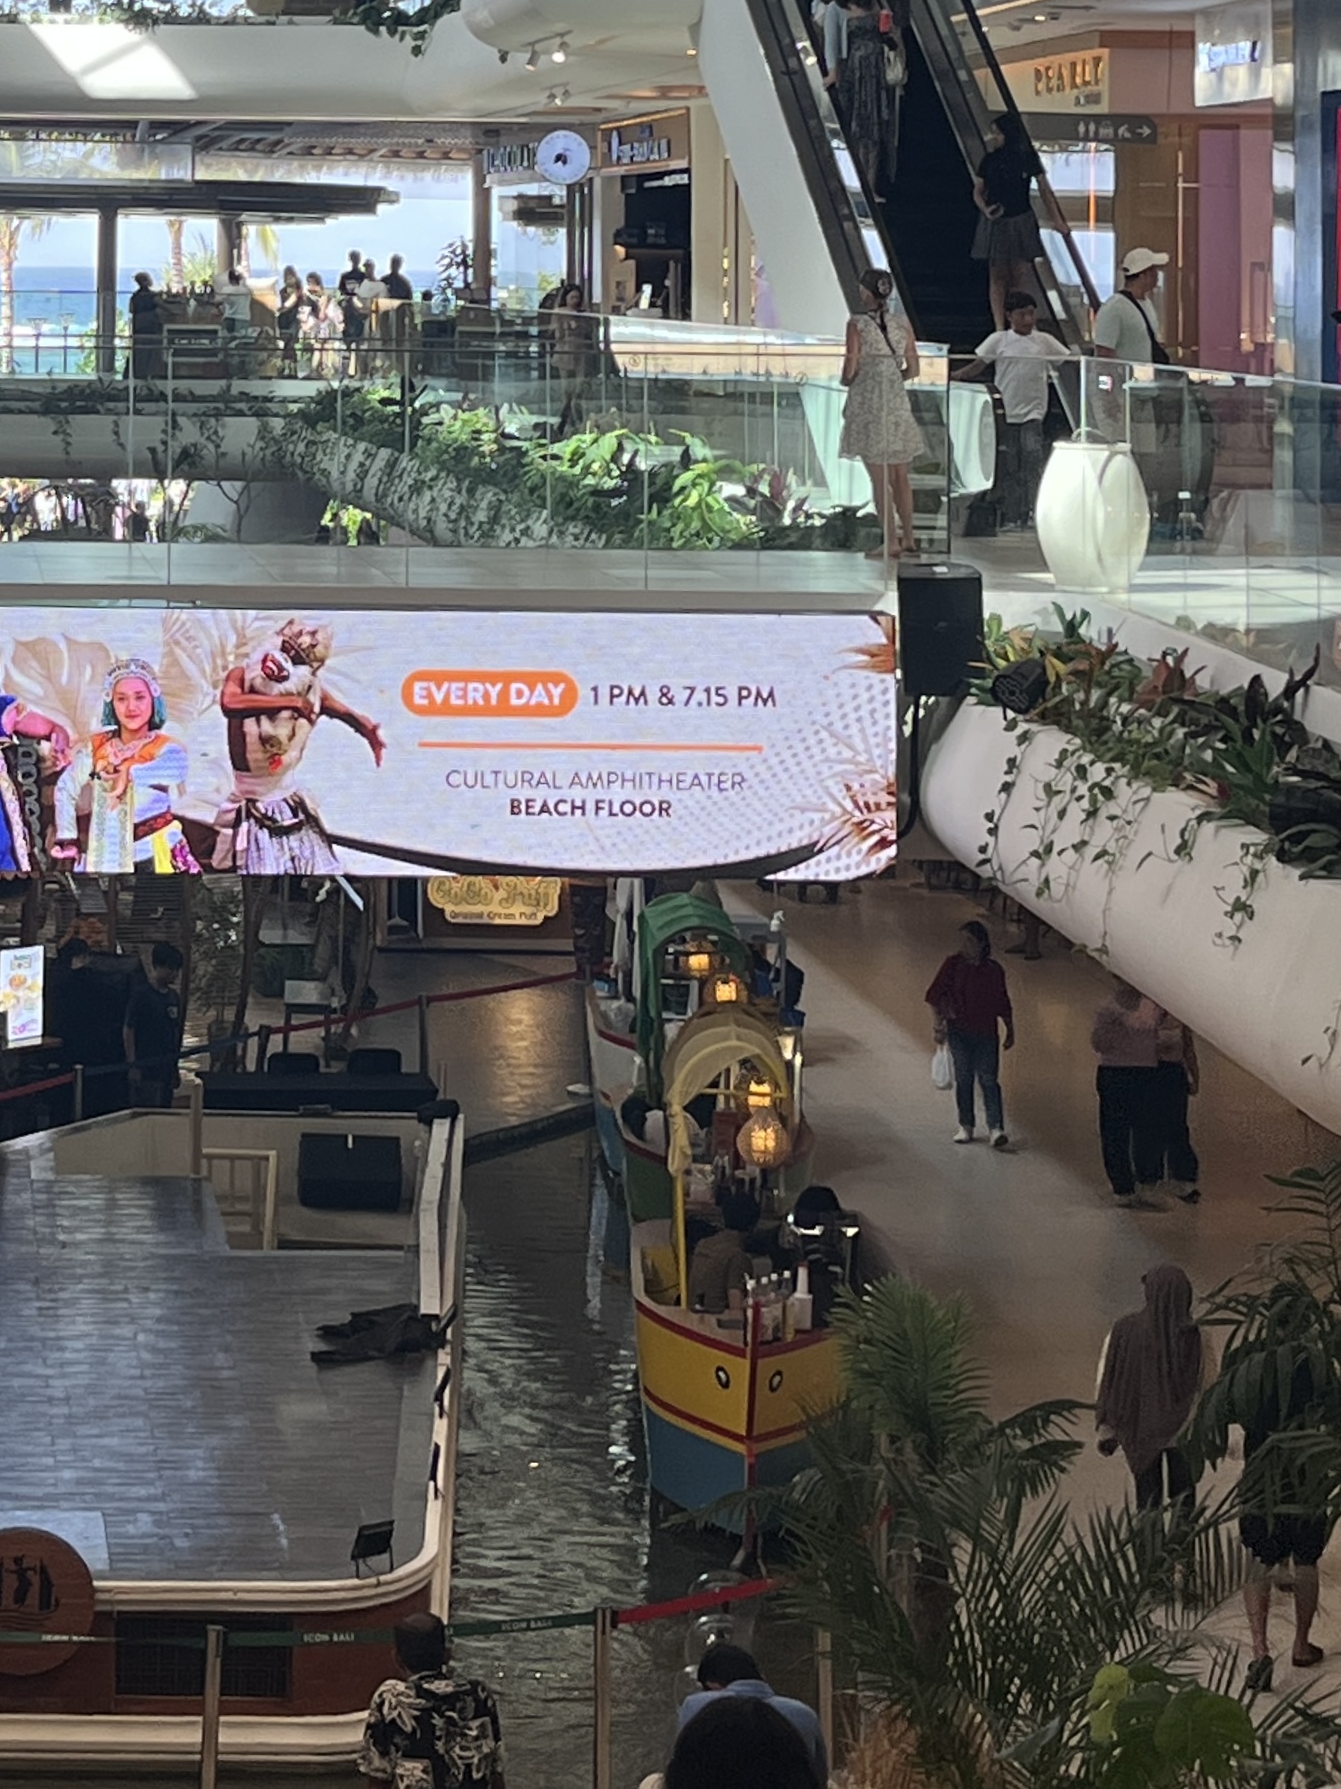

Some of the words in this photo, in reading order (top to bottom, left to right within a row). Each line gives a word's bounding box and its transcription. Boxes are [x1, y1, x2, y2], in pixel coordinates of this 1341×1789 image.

[1033, 55, 1103, 96] PEARLY
[412, 681, 504, 706] EVERY
[509, 682, 566, 707] DAY
[590, 685, 599, 706] 1
[609, 685, 648, 707] PM
[657, 685, 675, 707] &
[682, 685, 728, 708] 7.15
[737, 686, 777, 708] PM
[445, 769, 562, 790] CULTURAL
[569, 771, 746, 792] AMPHITHEATER
[509, 798, 587, 818] BEACH
[594, 799, 672, 818] FLOOR
